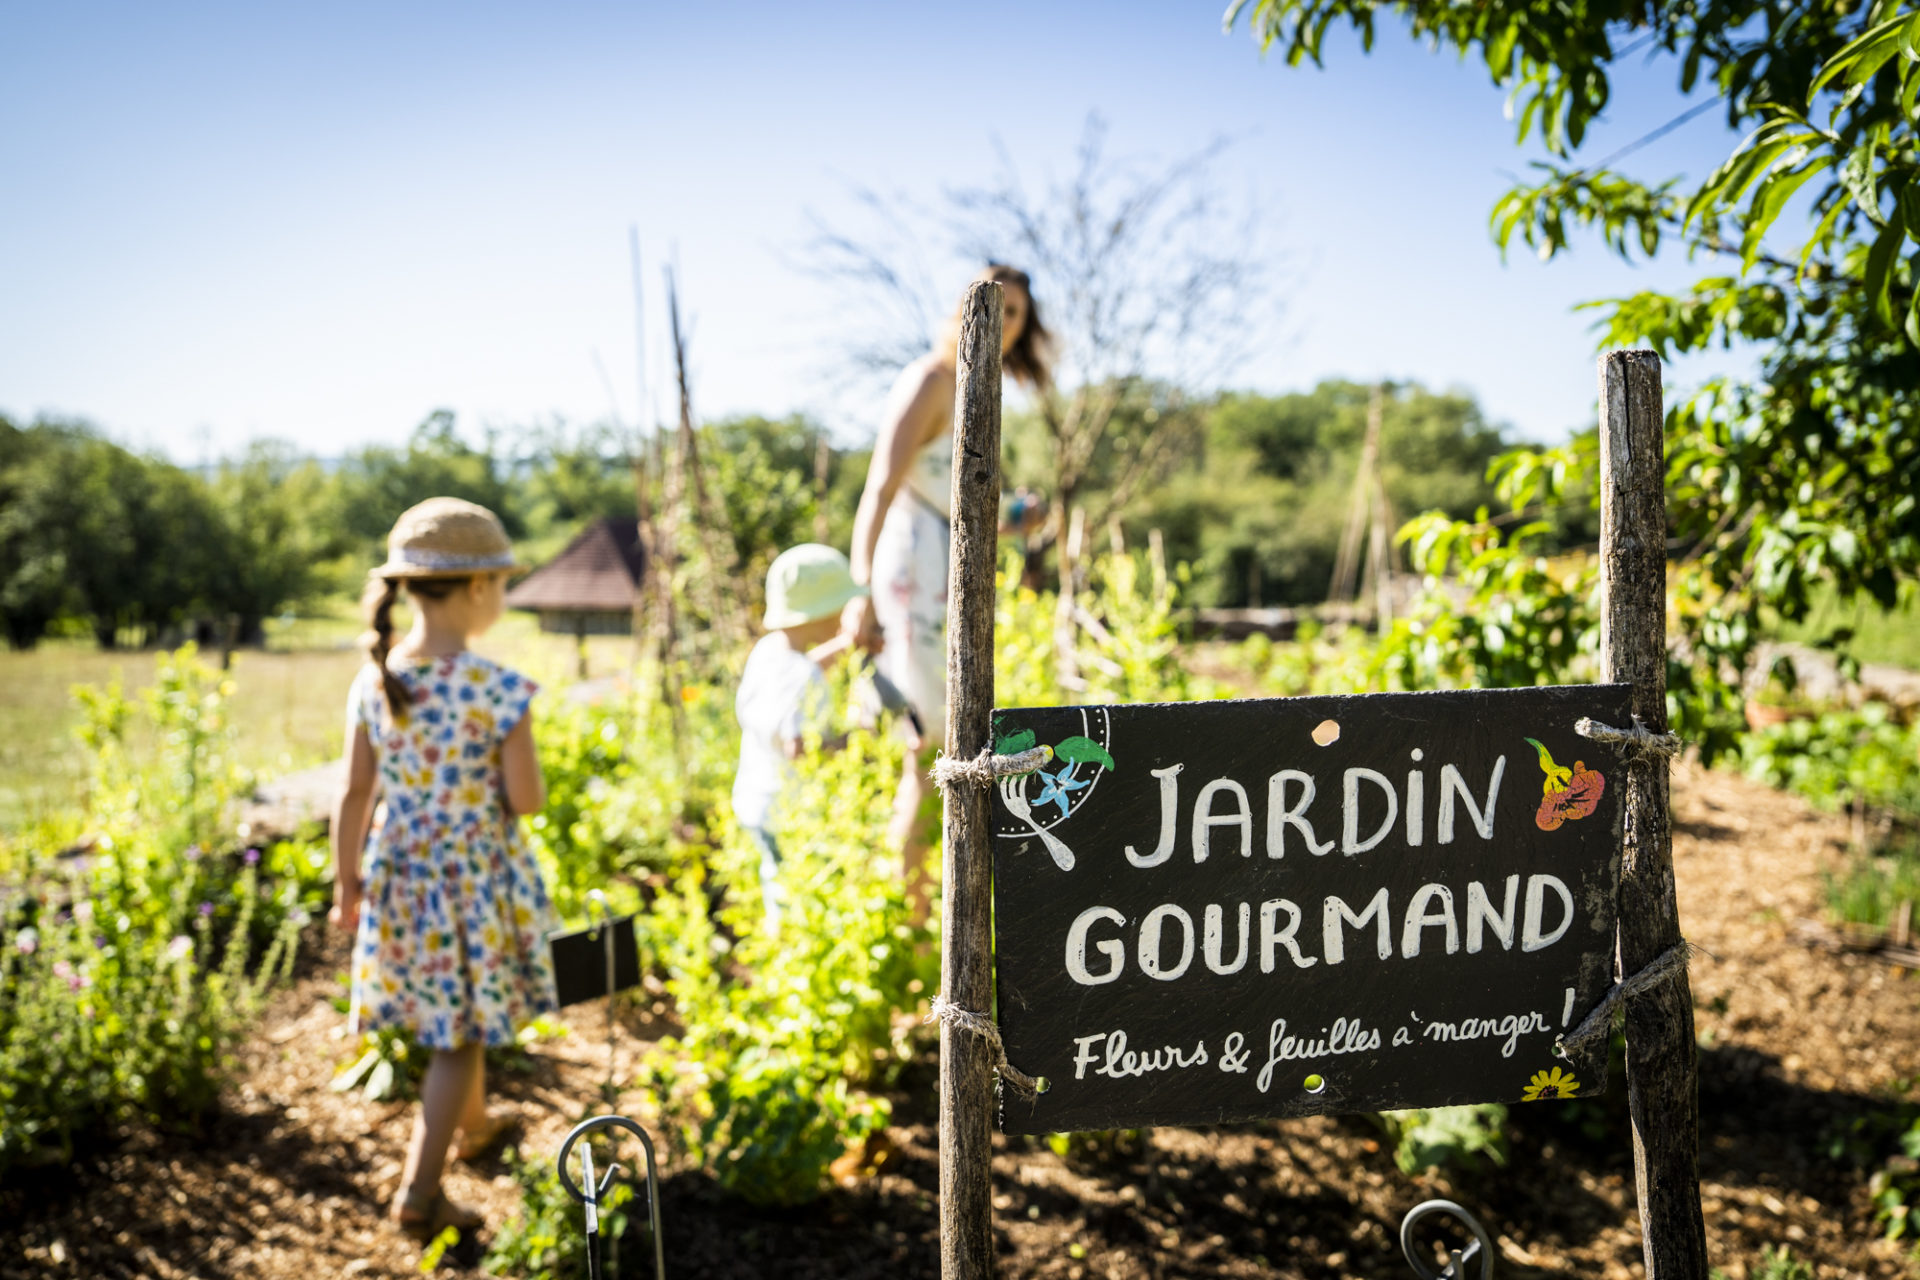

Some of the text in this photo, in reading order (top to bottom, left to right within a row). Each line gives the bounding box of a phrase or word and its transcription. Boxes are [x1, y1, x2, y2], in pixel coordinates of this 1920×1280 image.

[1065, 874, 1574, 986] GOURMAND
[1073, 1029, 1209, 1080] Fleurs
[1218, 1031, 1251, 1074] &
[1256, 1016, 1381, 1093] feuilles
[1392, 1010, 1420, 1047] à
